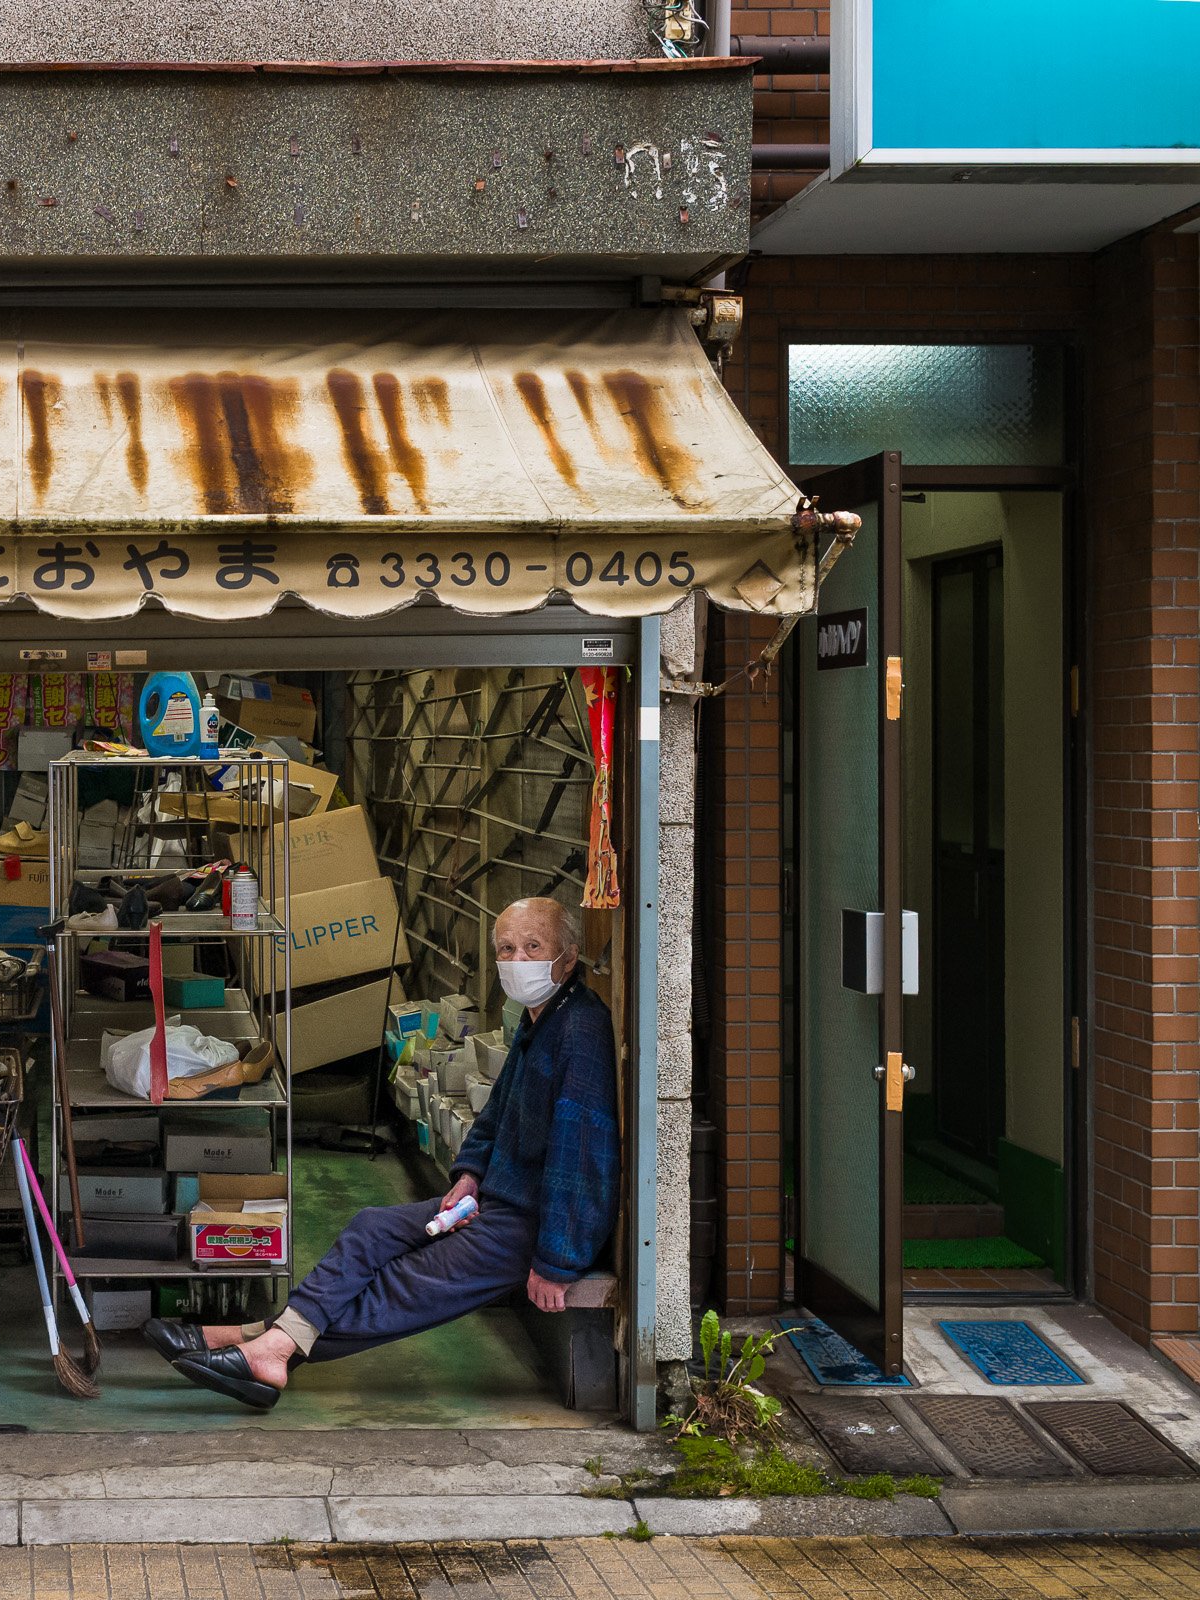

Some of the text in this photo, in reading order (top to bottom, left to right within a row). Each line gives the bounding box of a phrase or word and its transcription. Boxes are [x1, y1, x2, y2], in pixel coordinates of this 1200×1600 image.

[378, 550, 696, 588] 3330-0405
[275, 914, 380, 954] SLIPPER
[203, 1148, 225, 1156] Mode
[95, 1187, 117, 1196] Mode
